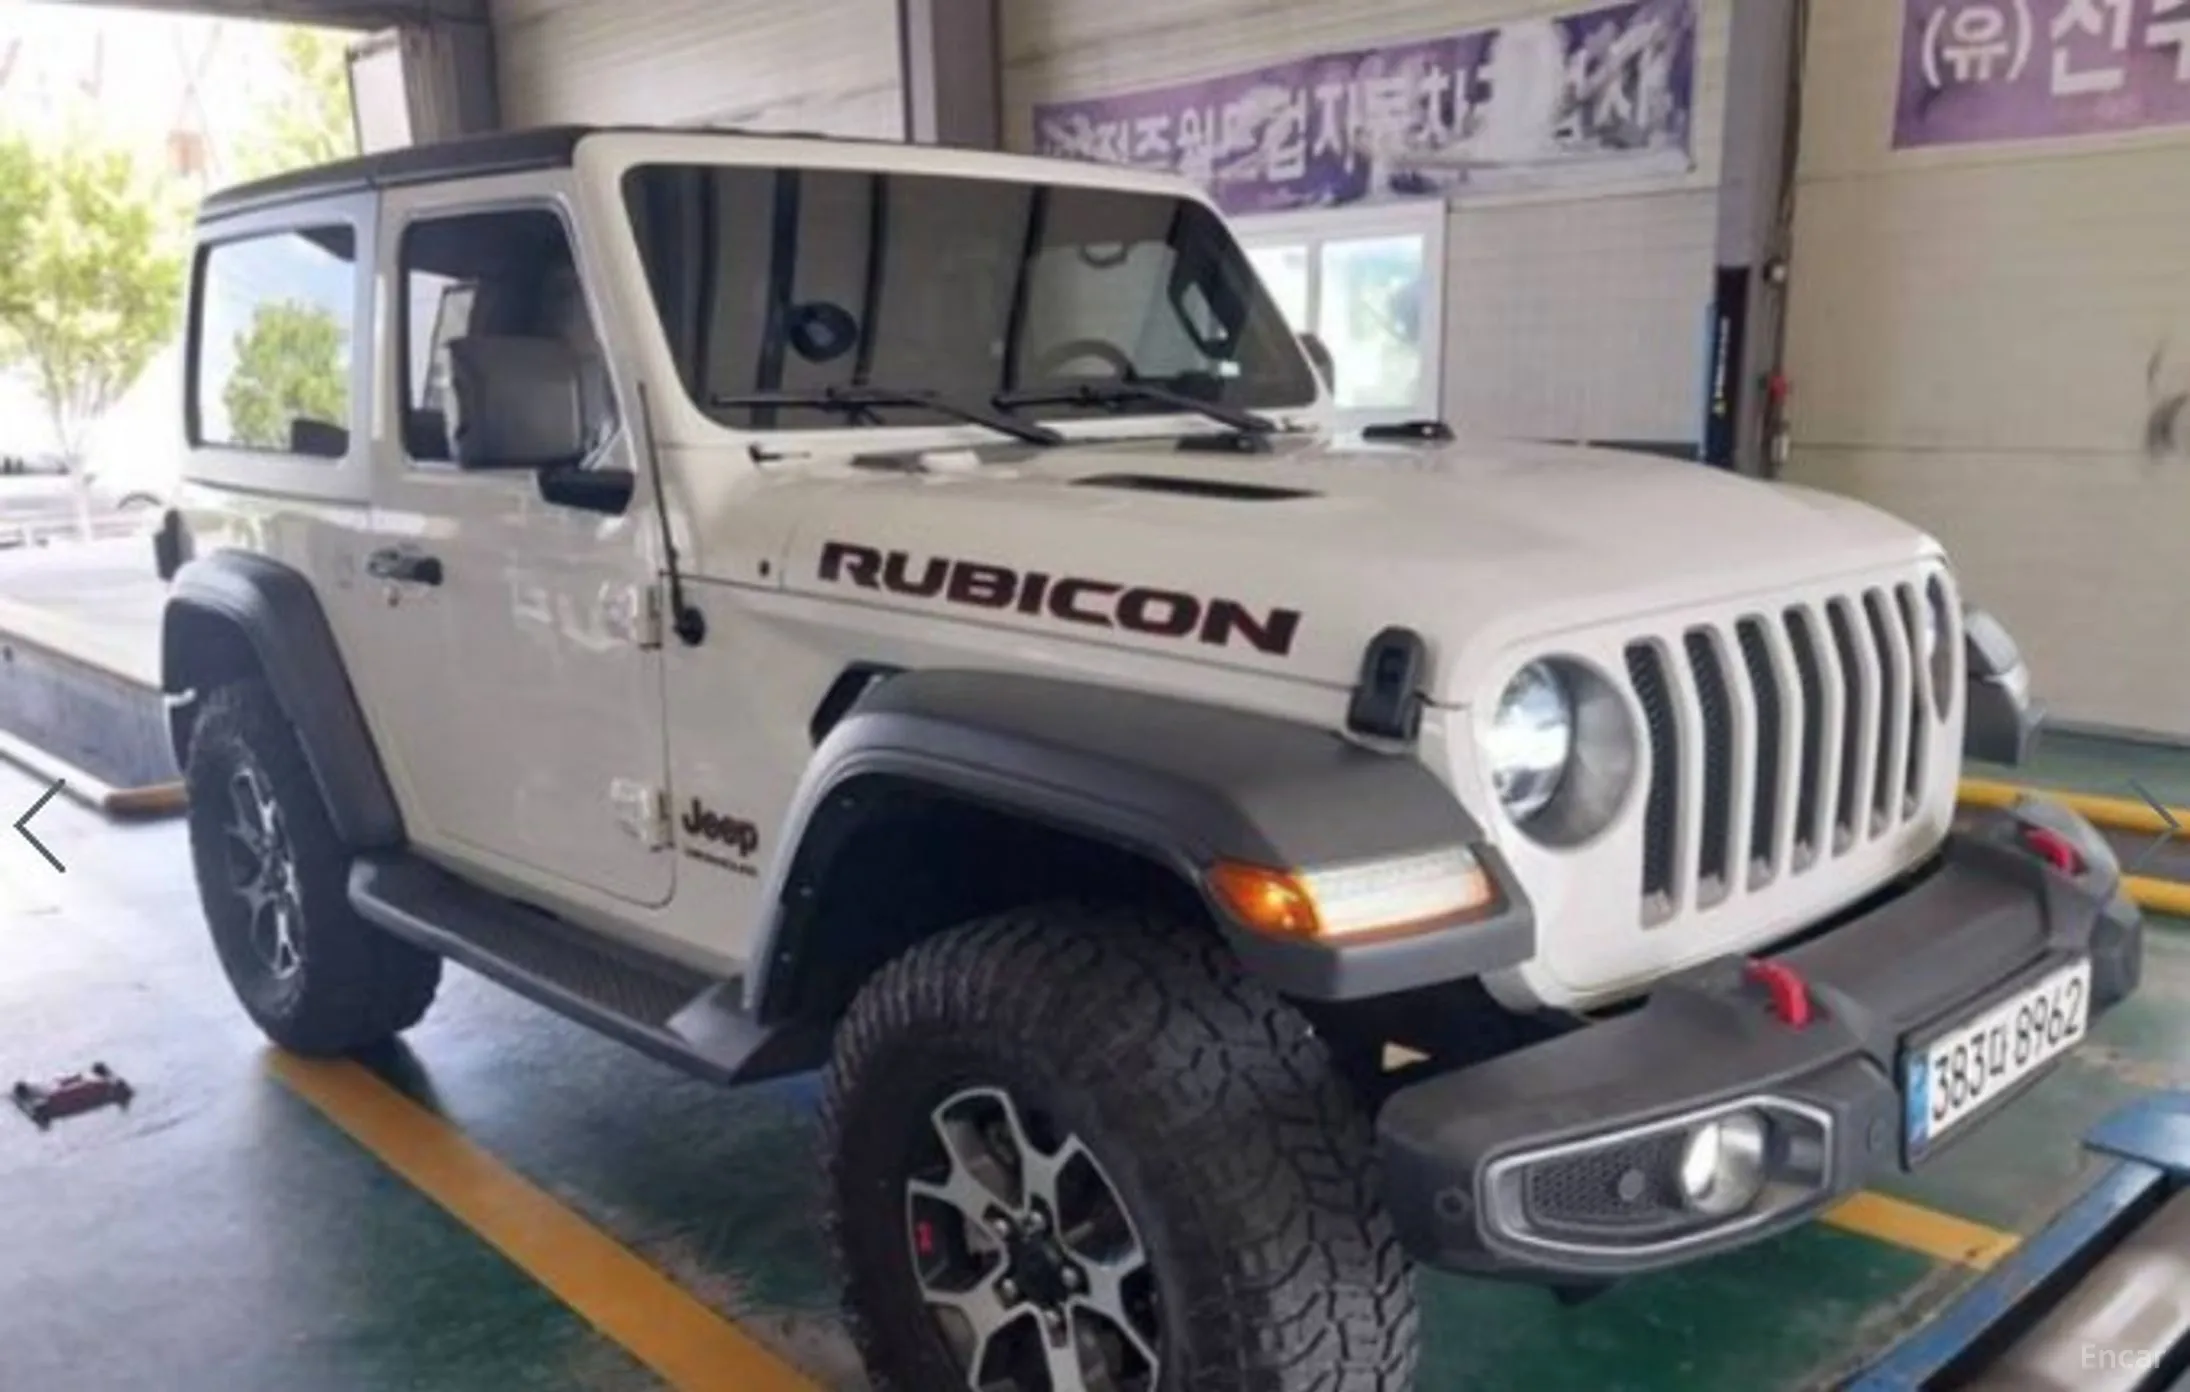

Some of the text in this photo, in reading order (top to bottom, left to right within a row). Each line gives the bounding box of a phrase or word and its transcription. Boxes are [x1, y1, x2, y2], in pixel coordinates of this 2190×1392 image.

[817, 541, 1302, 656] RUBICON
[681, 797, 759, 857] Jeep
[2014, 976, 2082, 1065] 8962
